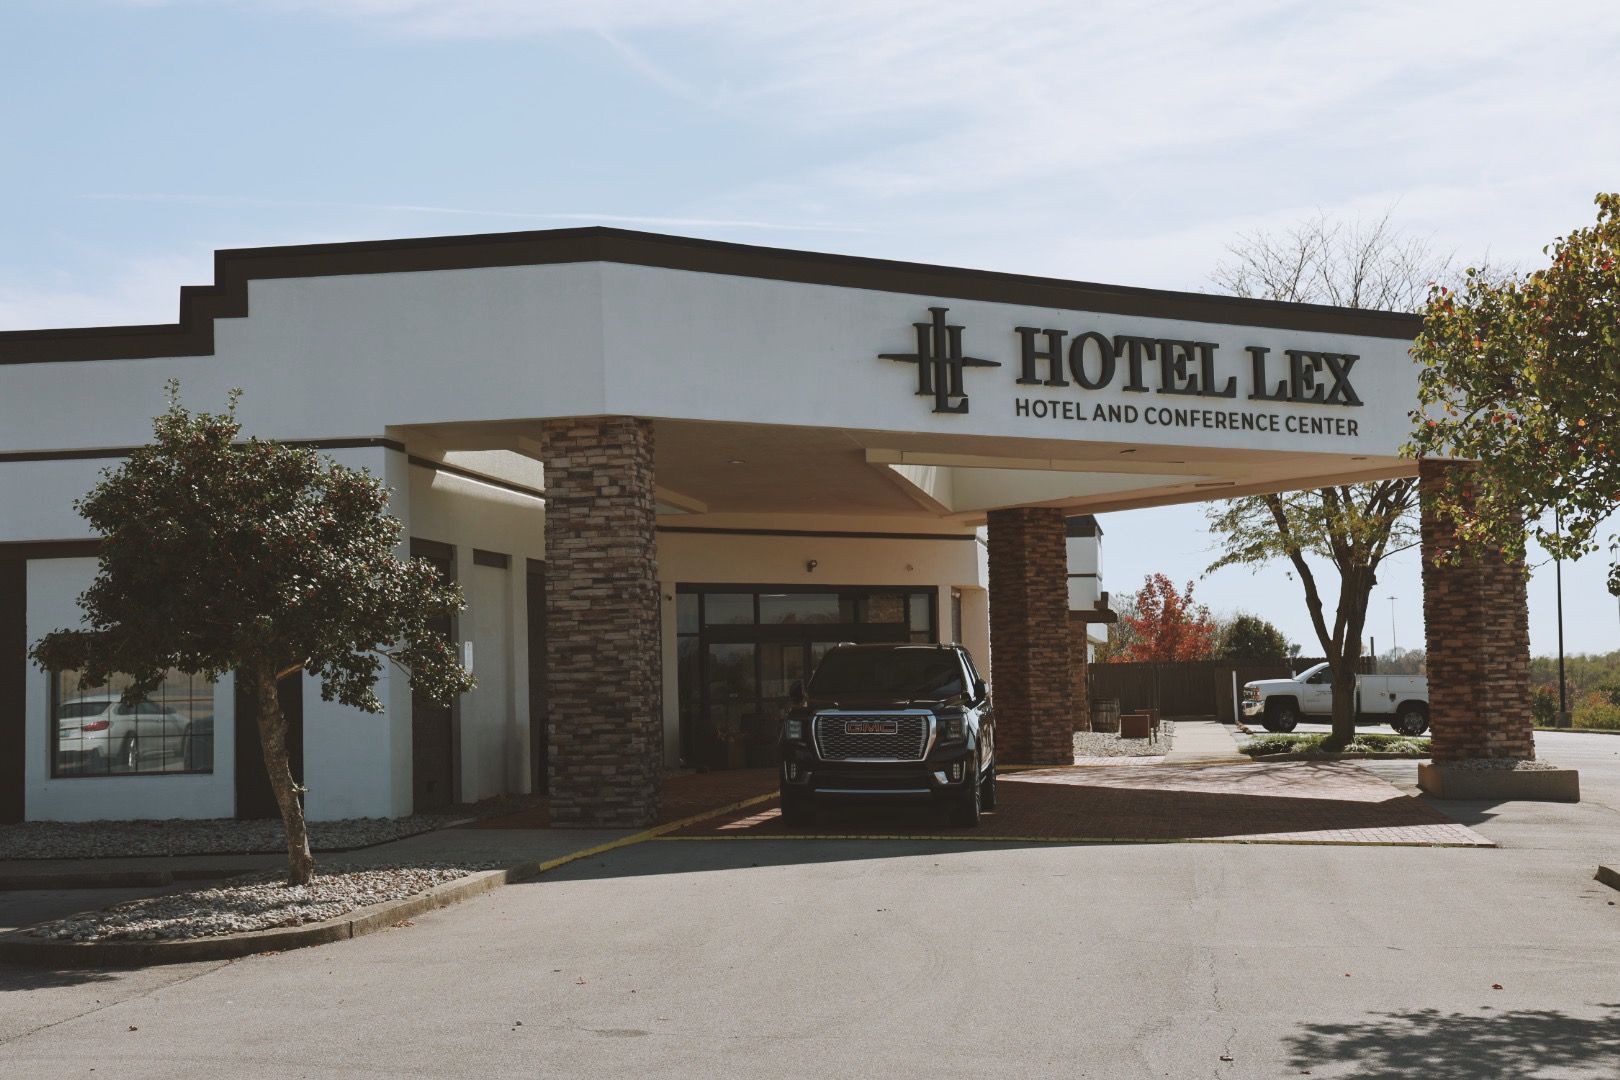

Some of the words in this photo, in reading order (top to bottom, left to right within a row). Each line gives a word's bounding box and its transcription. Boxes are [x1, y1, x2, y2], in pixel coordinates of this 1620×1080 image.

[1014, 326, 1237, 398] HOTEL
[1244, 346, 1364, 407] LEX
[1016, 398, 1087, 421] HOTEL
[1093, 404, 1139, 424] AND
[1144, 407, 1281, 433] CONFERENCE
[1284, 415, 1359, 437] CENTER
[847, 722, 895, 733] GMC
